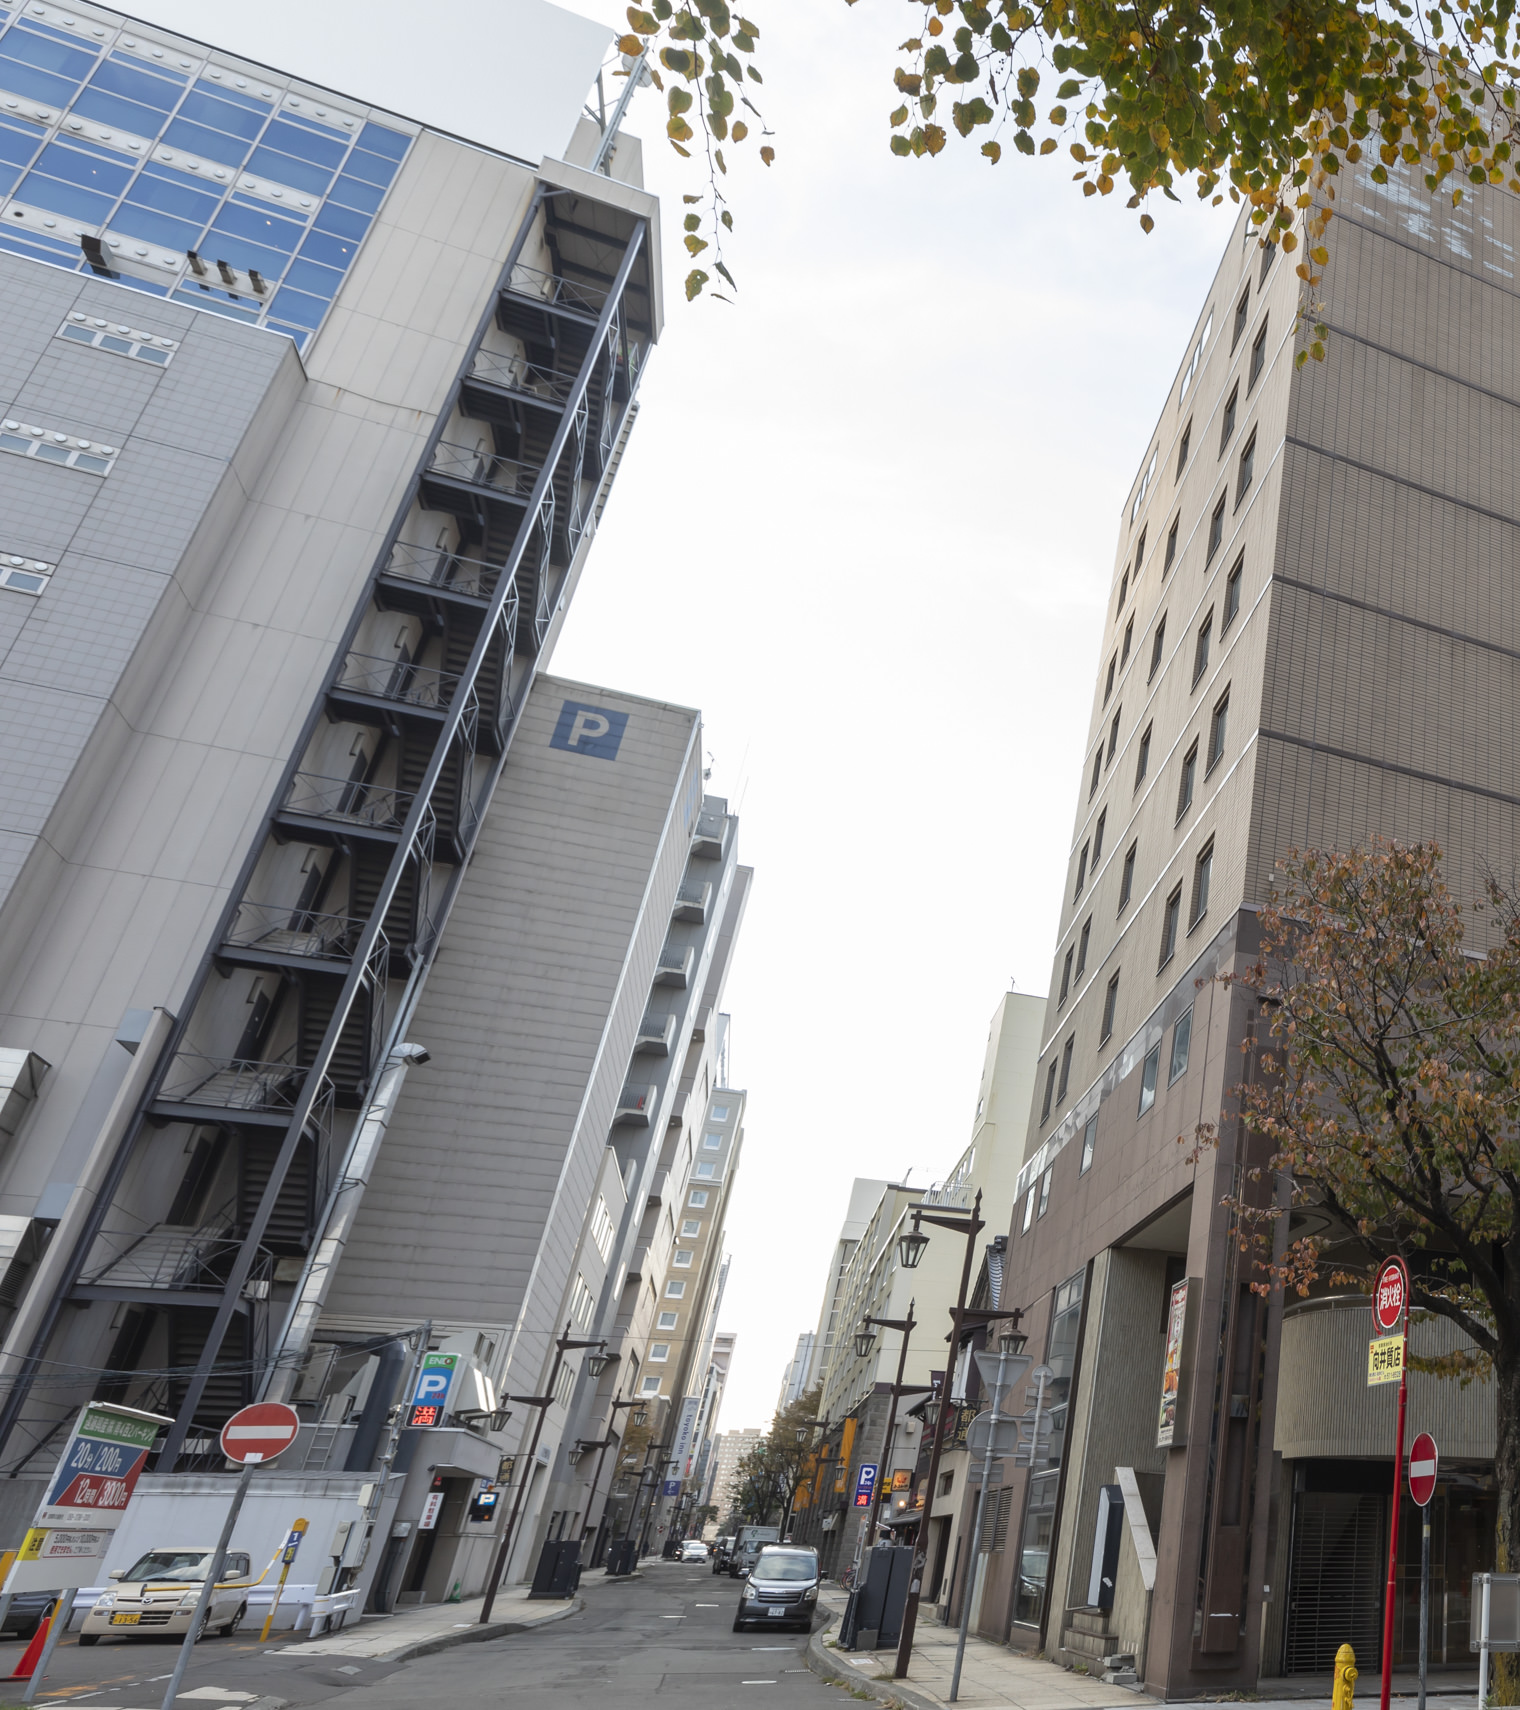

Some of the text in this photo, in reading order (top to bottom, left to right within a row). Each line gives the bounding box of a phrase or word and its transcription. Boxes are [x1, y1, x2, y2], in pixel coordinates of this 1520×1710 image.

[567, 710, 610, 746] P
[1380, 1282, 1401, 1311] 消火栓
[1373, 1345, 1401, 1371] 向井質店
[417, 1375, 447, 1399] P
[412, 1406, 437, 1425] 満
[677, 1414, 693, 1455] toyoko inn
[860, 1467, 874, 1485] P
[479, 1494, 495, 1505] P
